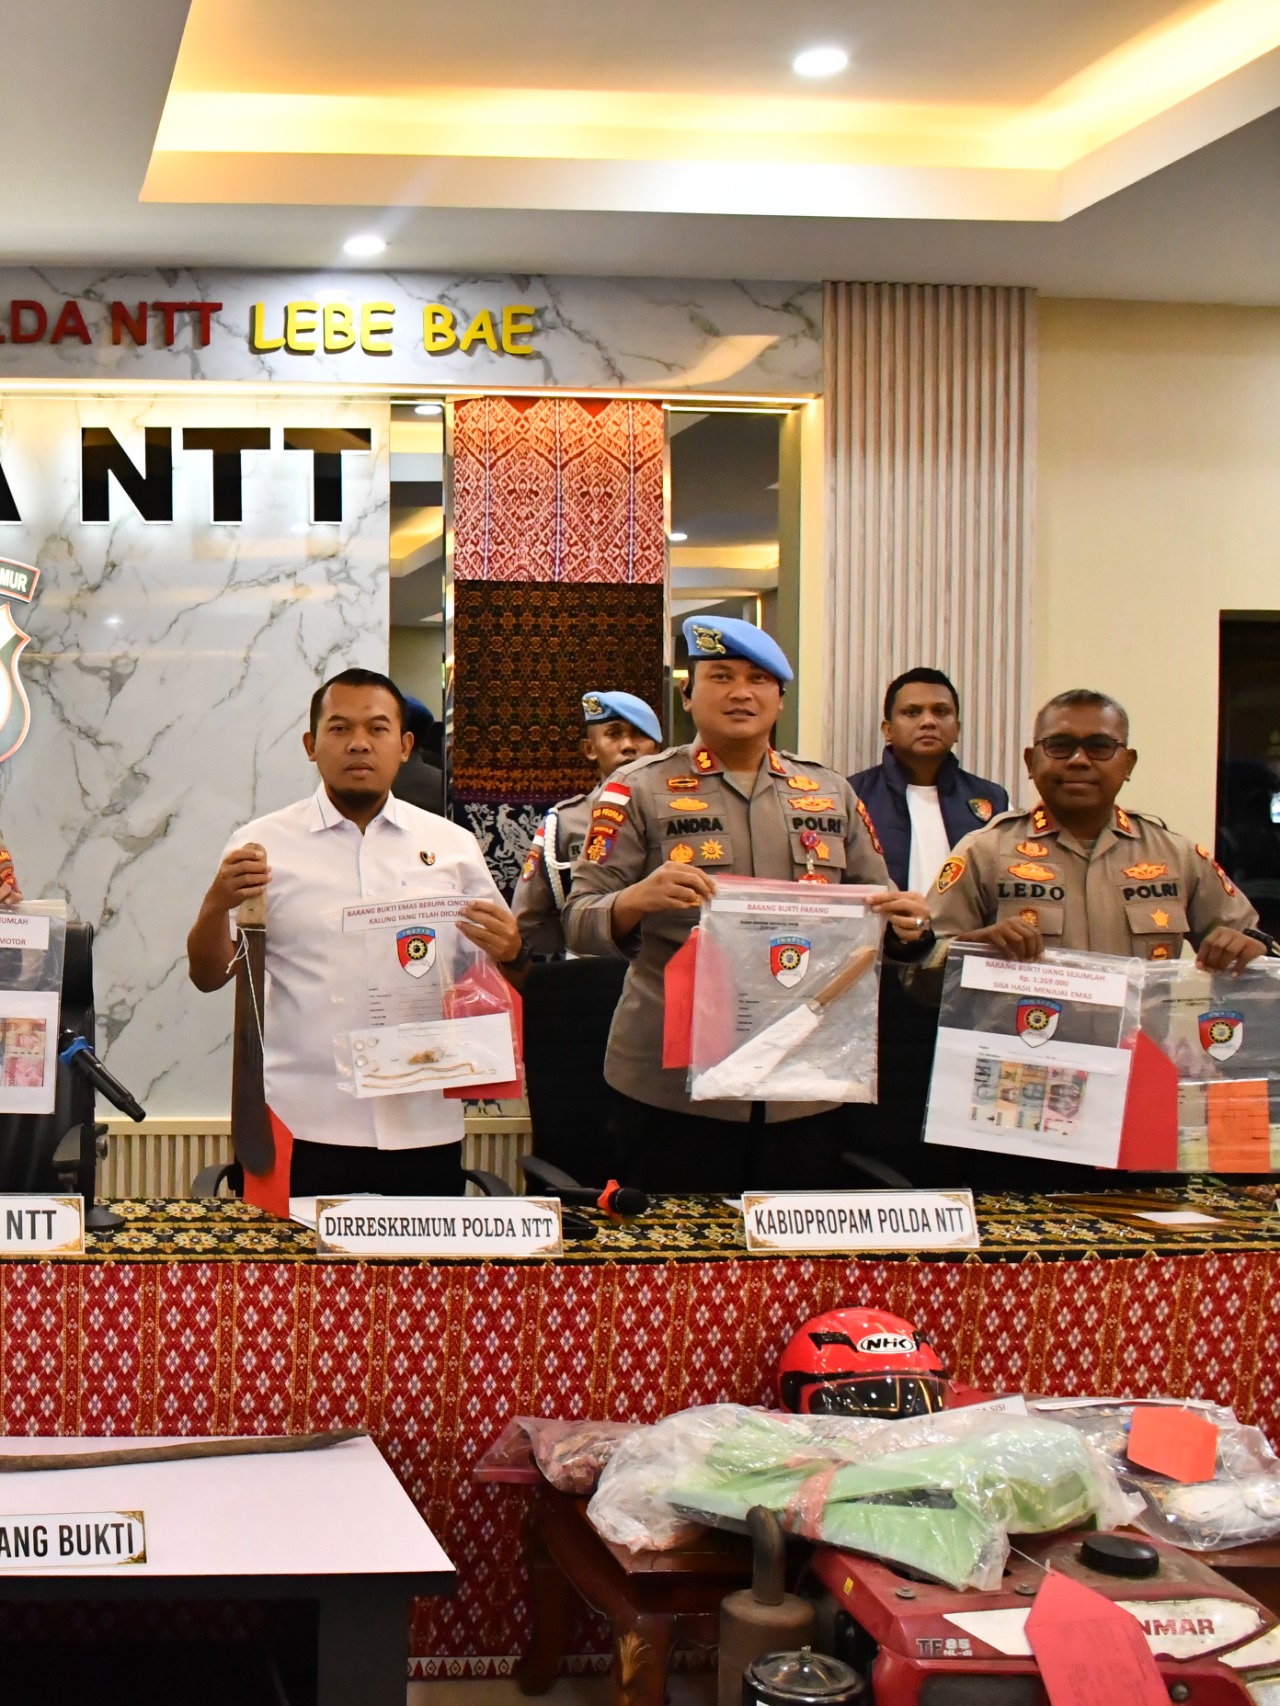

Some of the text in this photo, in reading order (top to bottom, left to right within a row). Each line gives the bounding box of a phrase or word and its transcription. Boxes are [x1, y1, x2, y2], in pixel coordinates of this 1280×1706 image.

[112, 301, 223, 347] NTT
[250, 301, 395, 353] LEBE
[423, 304, 535, 354] BAE
[81, 427, 372, 525] NTT
[666, 817, 723, 835] ANDRA
[792, 816, 842, 833] POLRI
[998, 882, 1065, 900] LEDO
[1123, 882, 1177, 900] POLRI
[347, 908, 375, 917] BARANG
[376, 906, 397, 914] BUKTI
[398, 903, 417, 911] EMAS
[418, 901, 446, 909] BERUPA
[747, 904, 776, 912] BARANG
[800, 906, 829, 914] PARANG
[369, 916, 396, 924] KALUNG
[985, 961, 1106, 981] BARANG BUKTI UANG SEJUMLAH
[993, 981, 1092, 1000] SISA HASIL MENJUAL EMAS
[6, 1210, 57, 1241] NTT
[324, 1216, 553, 1239] DIRRESKRIMUM POLDA NTT
[754, 1207, 965, 1236] KABIDPROPAM POLDA NTT
[59, 1522, 135, 1558] BUKTI
[1141, 1618, 1215, 1636] NMAR
[916, 1638, 971, 1657] TF 85
